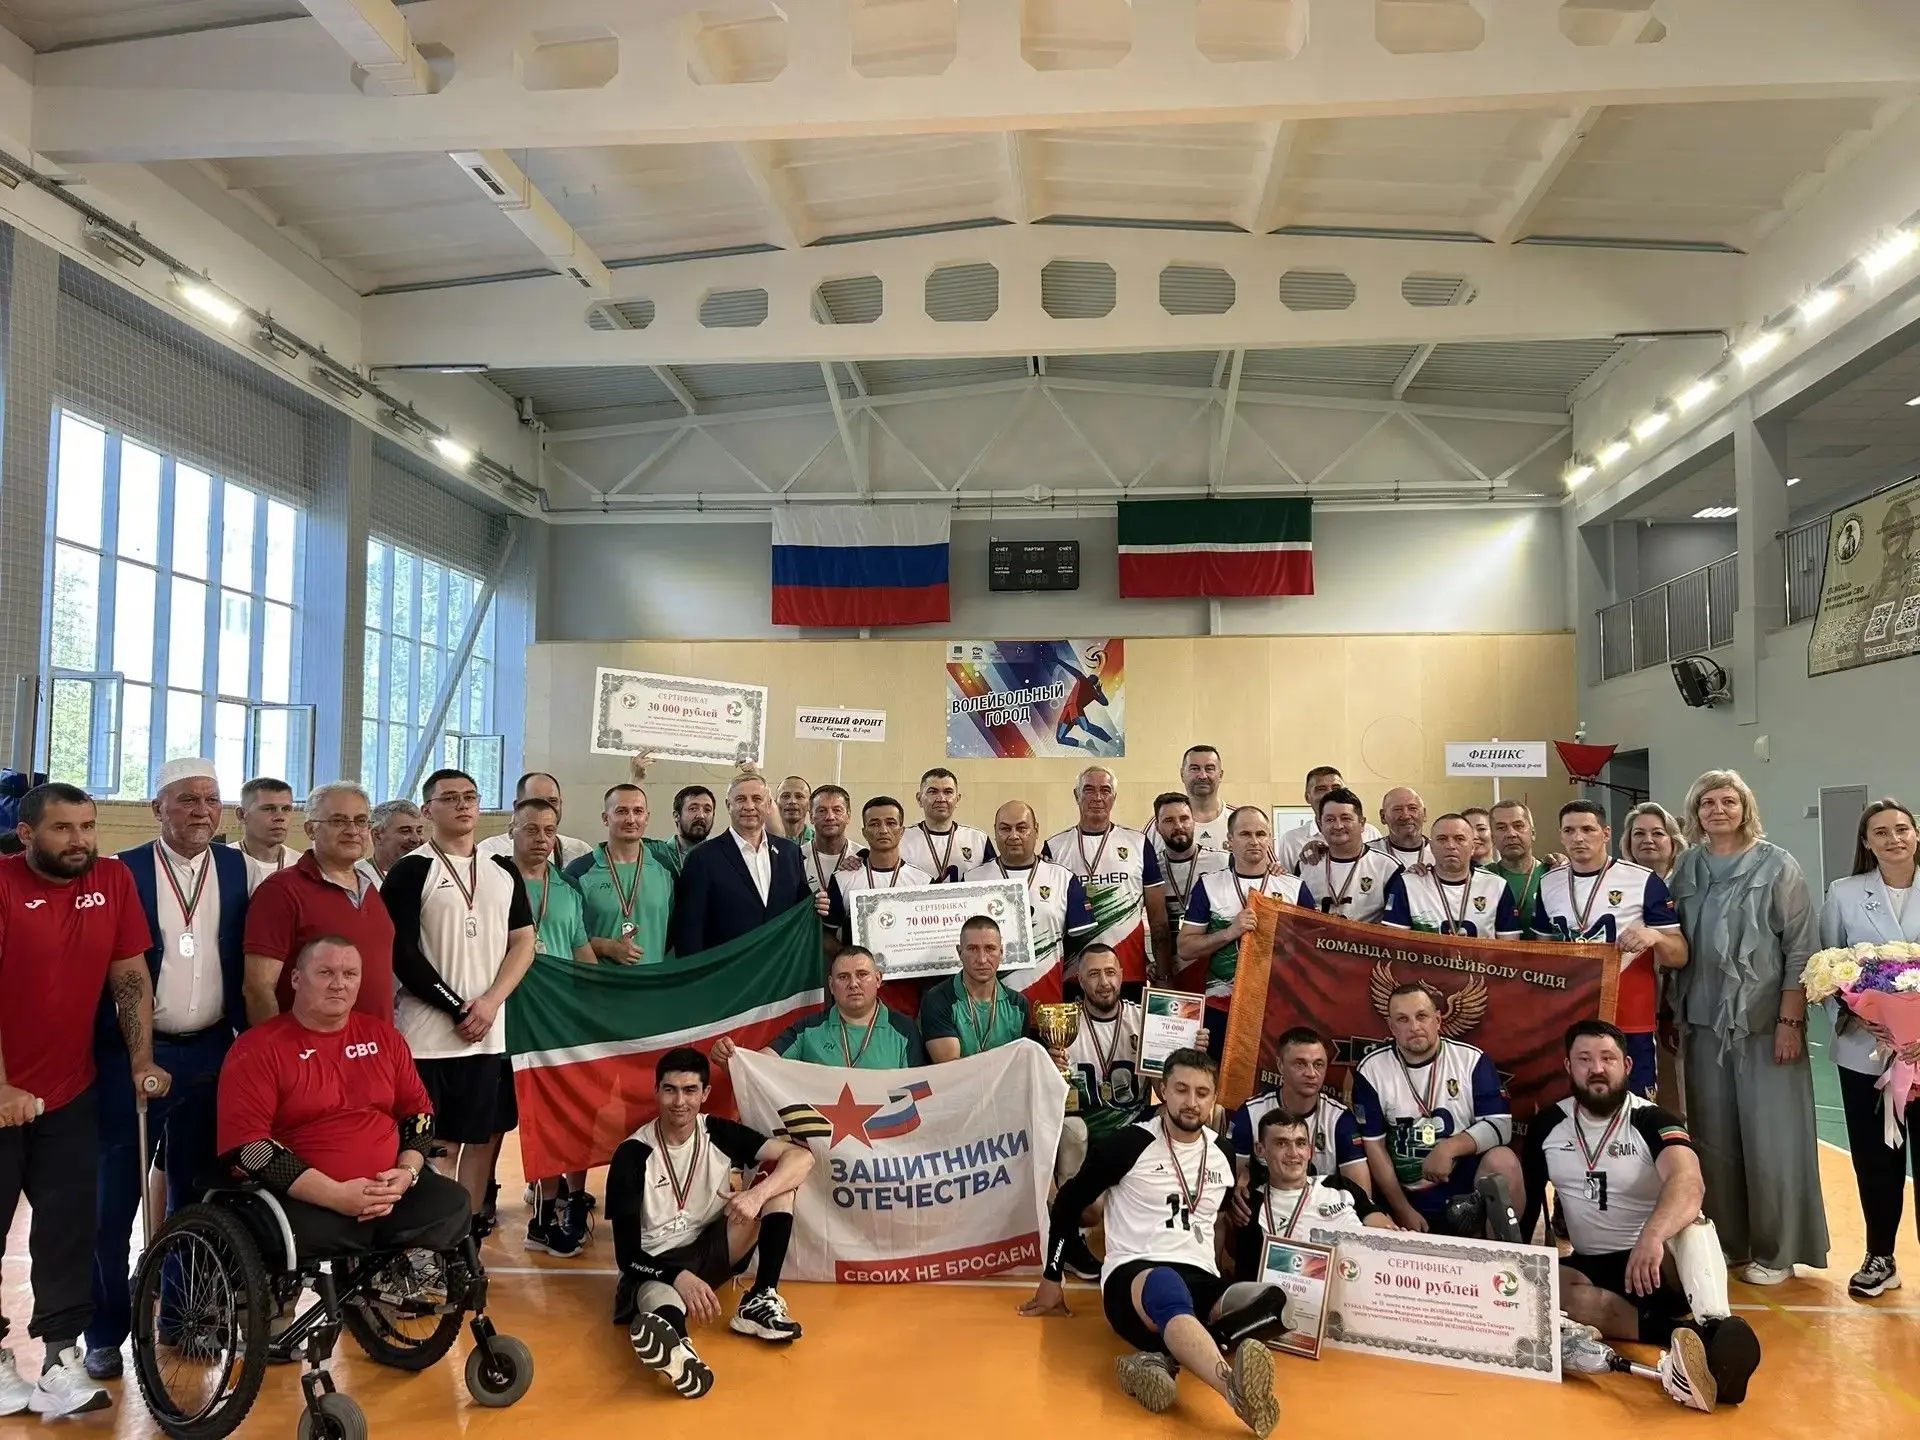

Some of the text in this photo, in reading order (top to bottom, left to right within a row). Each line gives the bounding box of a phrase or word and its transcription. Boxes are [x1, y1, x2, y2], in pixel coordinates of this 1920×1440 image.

[658, 693, 708, 704] СЕРТИФИКАТ
[952, 682, 1064, 714] ВОЛЕЙБОЛЬНЫЙ
[648, 702, 718, 718] 30 000 рублей
[986, 708, 1030, 727] ГОРОД
[800, 715, 884, 727] СЕВЕРНЫЙ ФРОНТ
[1469, 749, 1525, 759] ФЕНИКС
[1078, 872, 1129, 887] РЕНЕР
[75, 892, 106, 910] СВО
[915, 902, 968, 912] СЕРТИФИКАТ
[906, 912, 977, 926] 70 000 рубл
[1316, 937, 1567, 989] КОМАНДА ПО ВОЛЕЙБОЛУ СИДЯ
[345, 1041, 379, 1059] СВО
[829, 1128, 1030, 1184] ЗАЩИТНИКИ
[832, 1165, 1011, 1210] ОТЕЧЕСТВА
[843, 1243, 1036, 1283] СВОИХ НЕ БРОСАЕМ
[1388, 1258, 1464, 1276] СЕРТИФИКАТ
[1374, 1272, 1479, 1298] 50 000 рублей
[1493, 1300, 1520, 1309] ФВРТ
